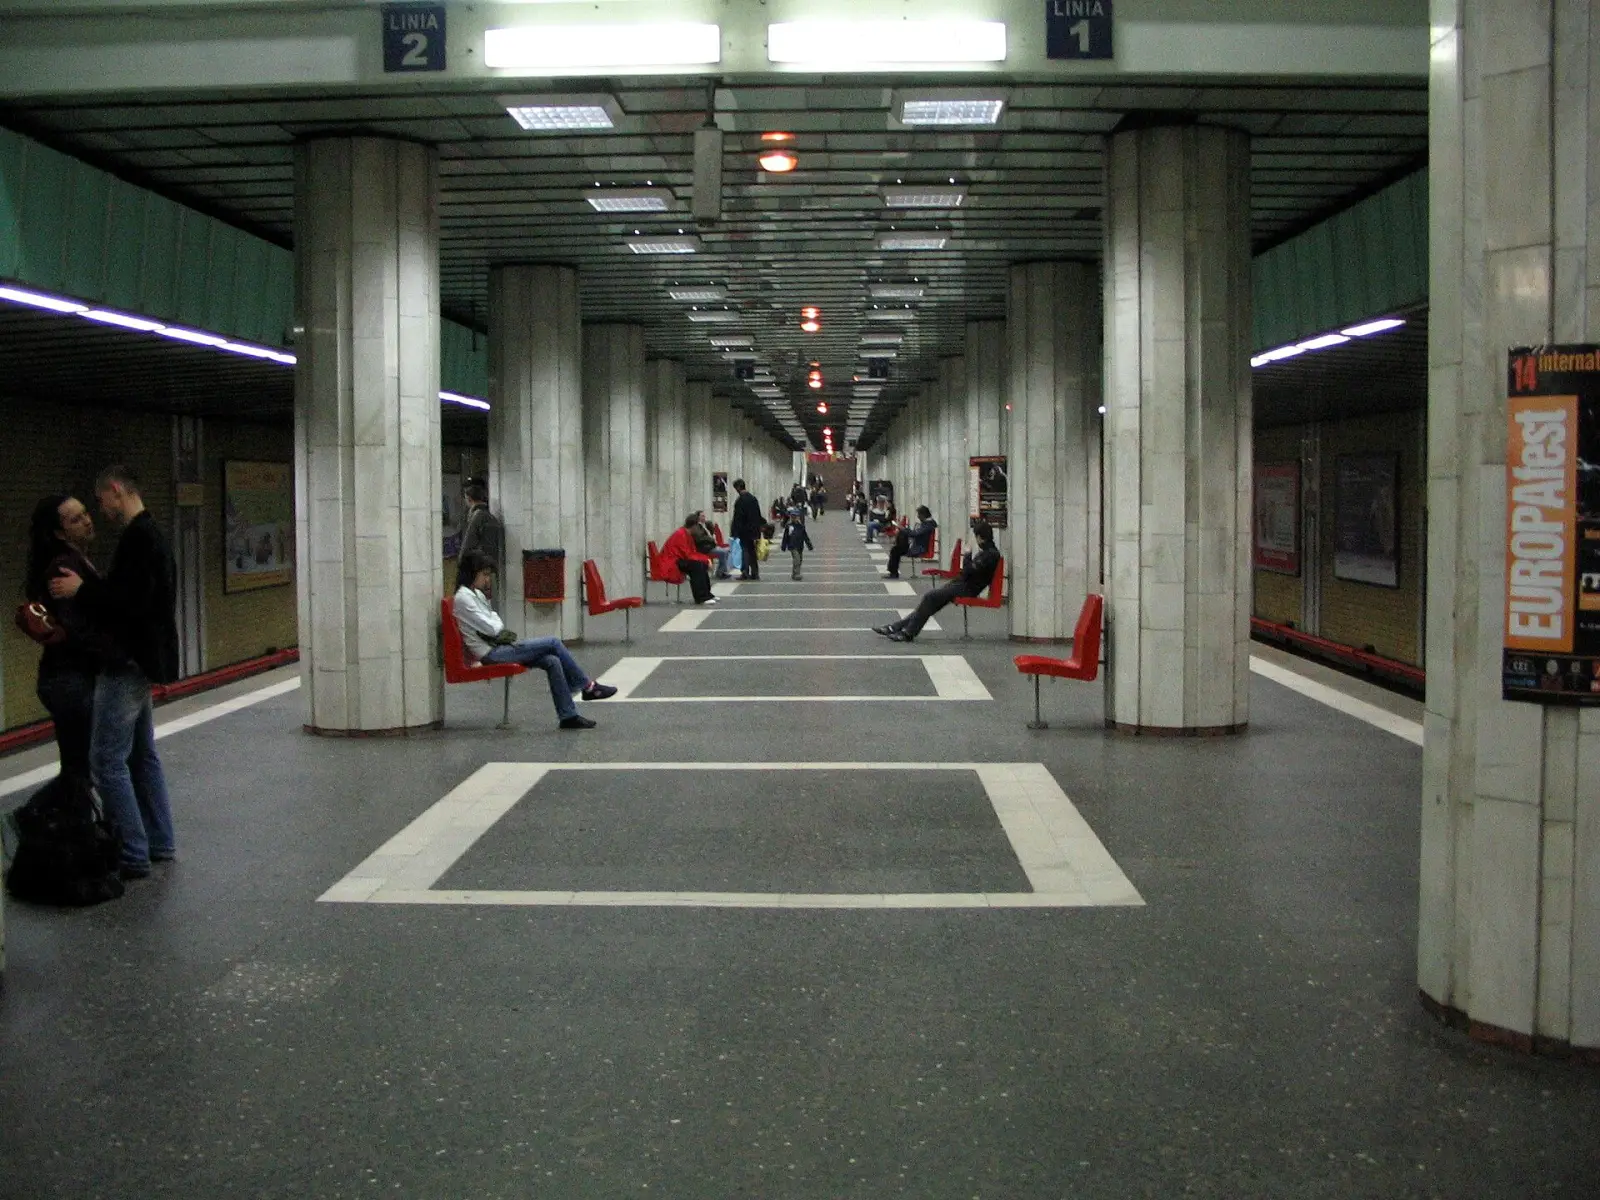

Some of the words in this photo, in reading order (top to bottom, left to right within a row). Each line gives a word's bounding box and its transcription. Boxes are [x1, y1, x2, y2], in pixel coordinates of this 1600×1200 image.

[389, 12, 438, 30] LINIA
[1054, 0, 1105, 17] LINIA
[402, 32, 428, 66] 2
[1069, 19, 1090, 52] 1
[1512, 355, 1537, 391] 14
